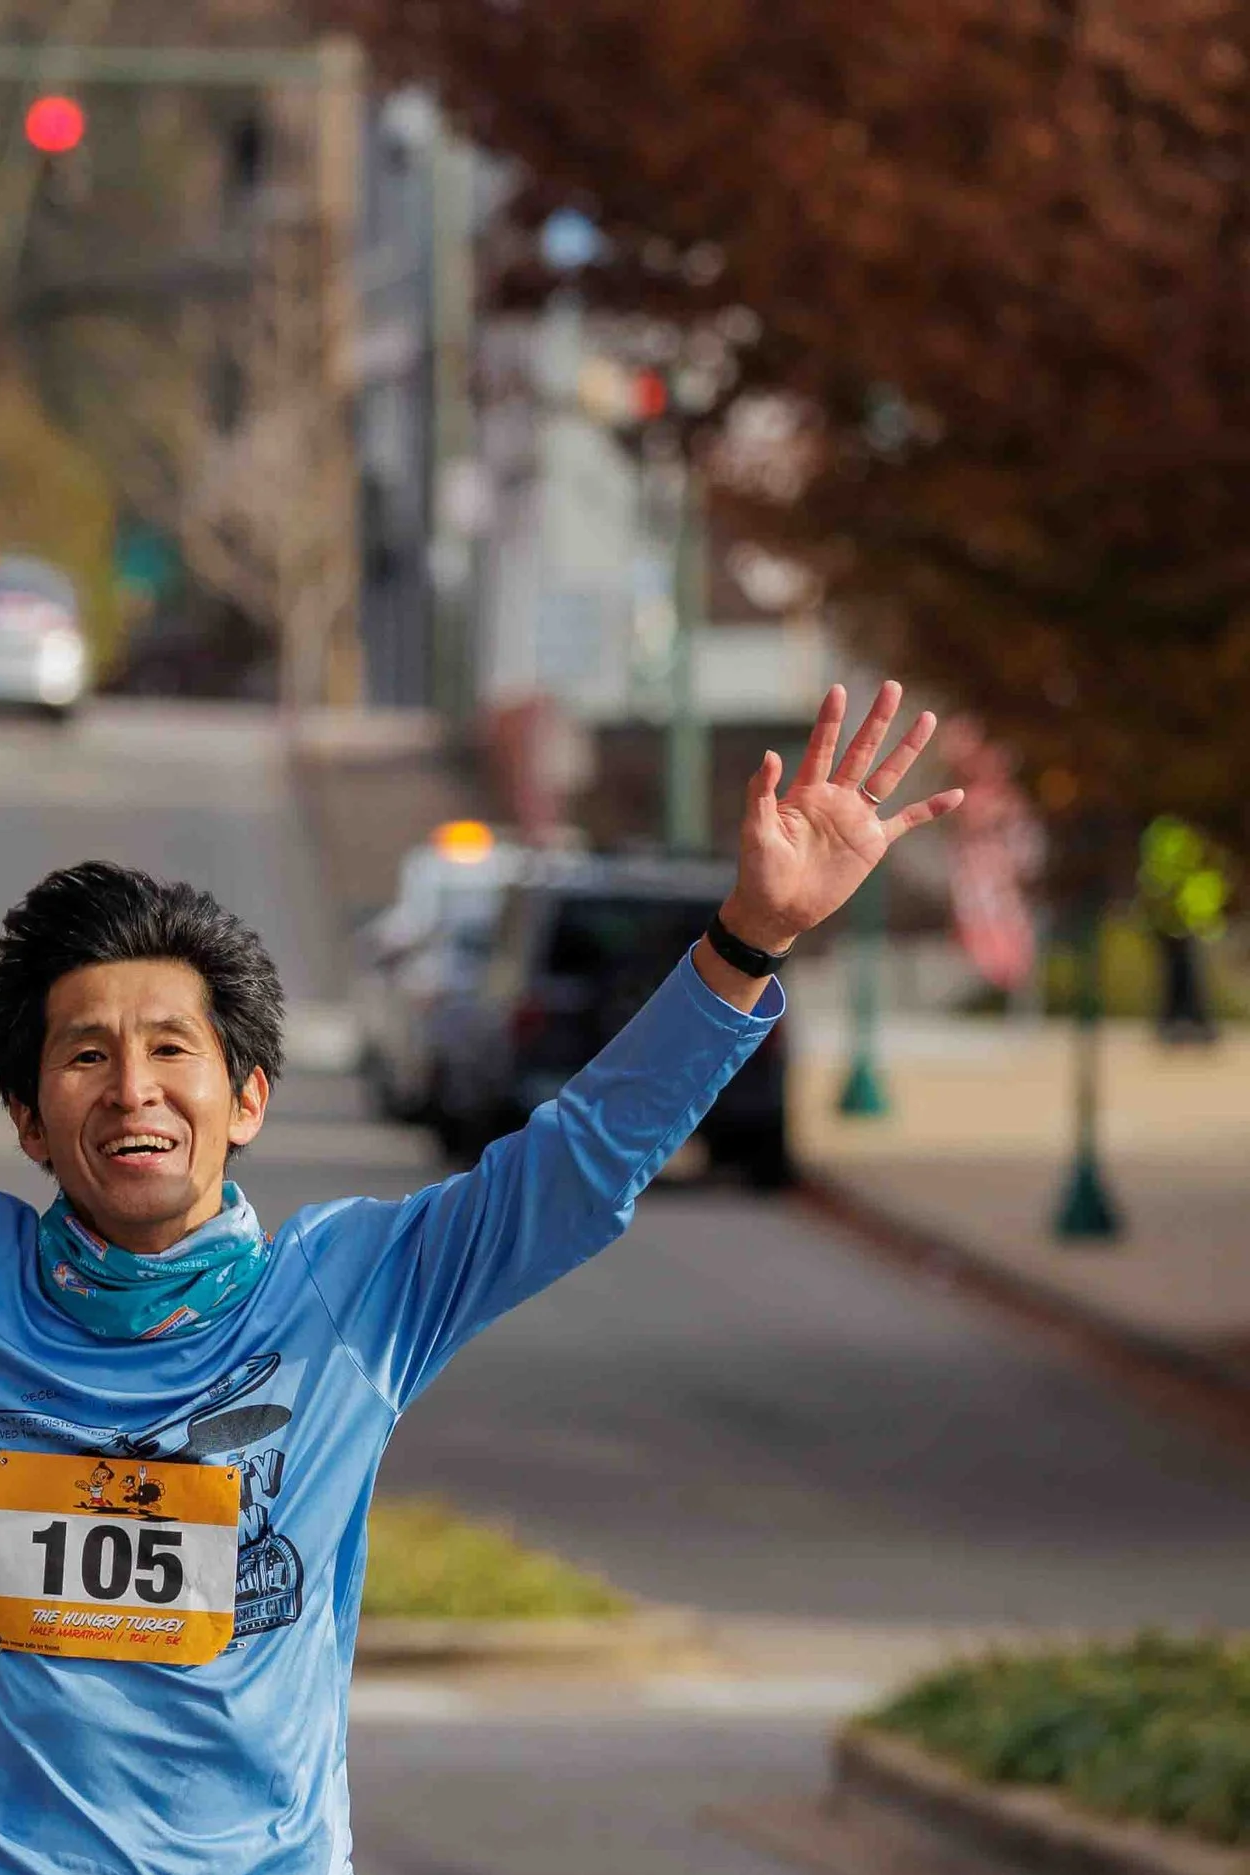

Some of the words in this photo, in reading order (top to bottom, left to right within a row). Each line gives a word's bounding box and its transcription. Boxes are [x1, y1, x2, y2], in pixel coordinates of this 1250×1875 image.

[20, 1417, 38, 1427] GET
[41, 1418, 110, 1438] DISTRTED
[32, 1520, 184, 1604] 105
[33, 1609, 61, 1624] THE
[61, 1611, 123, 1630] HUNGRY
[126, 1615, 186, 1634] TURKEY
[29, 1626, 55, 1638] HALF
[56, 1627, 113, 1641] MARATHON
[129, 1632, 149, 1644] 10K
[165, 1635, 182, 1646] 5K
